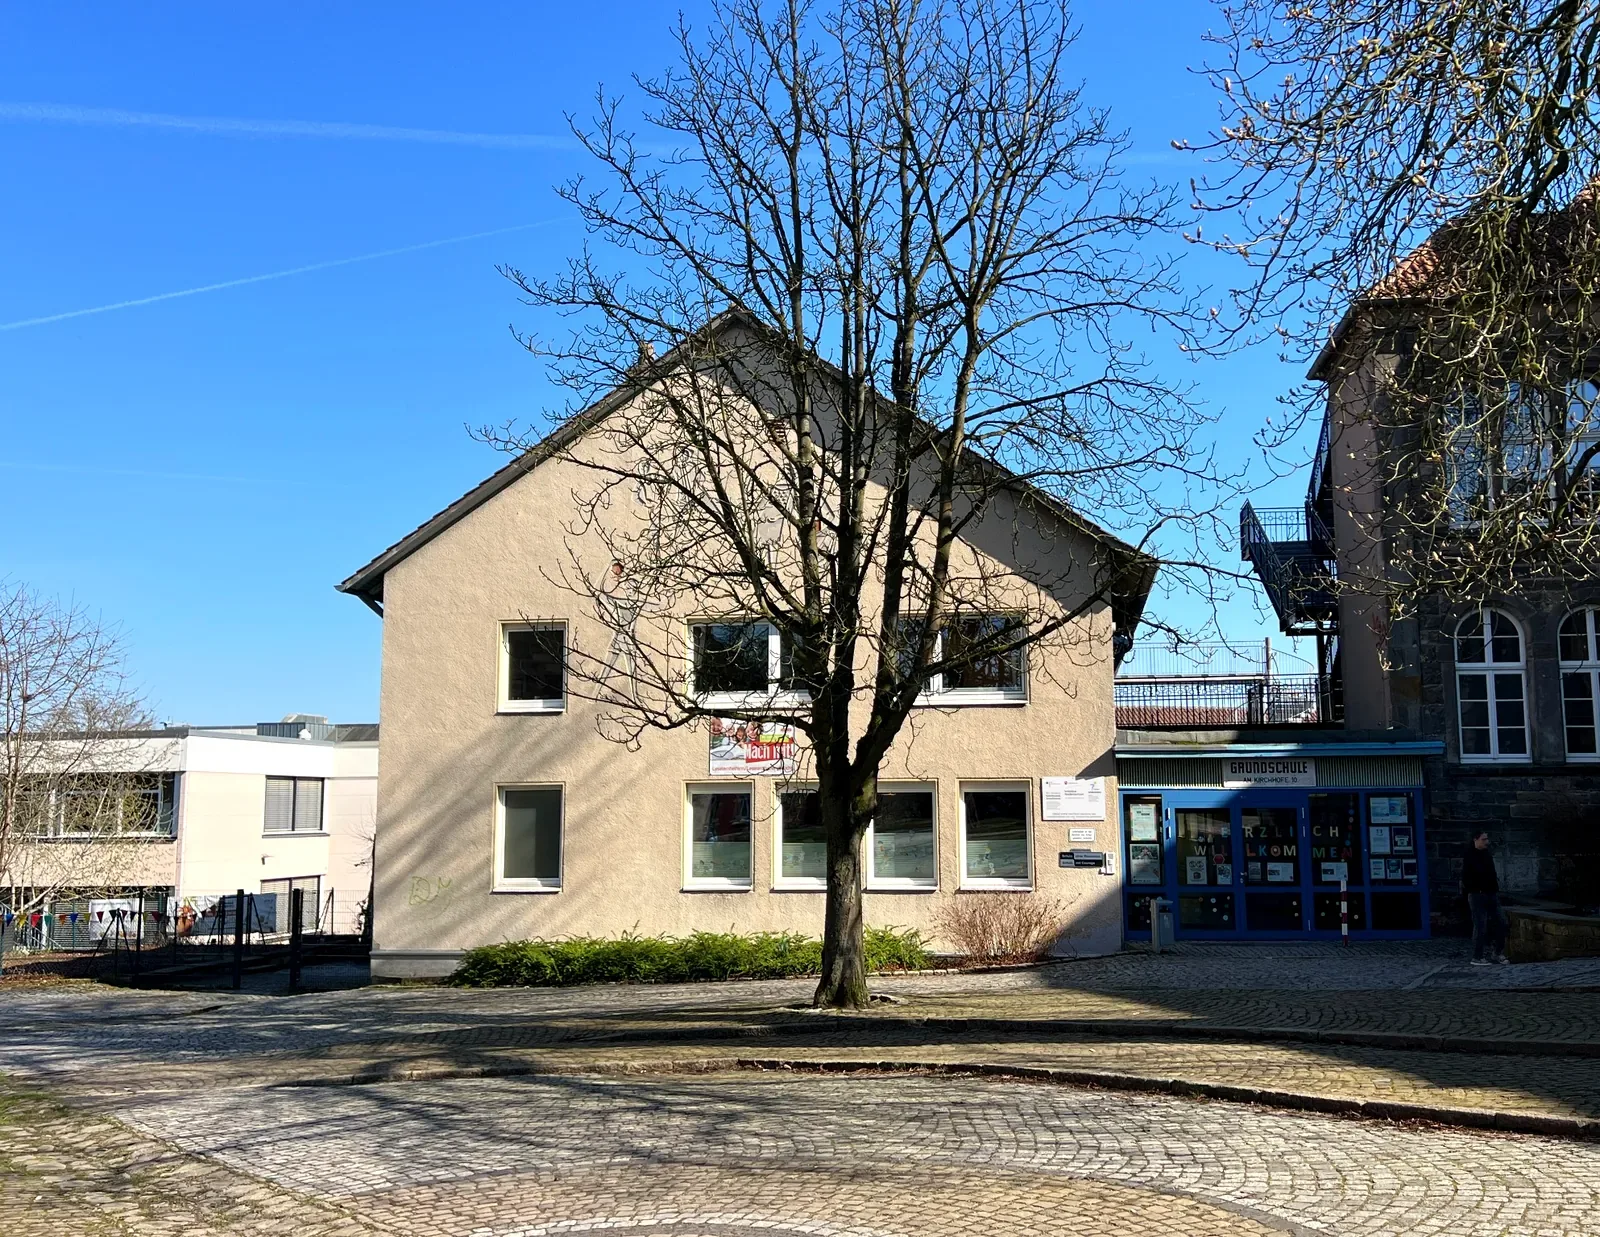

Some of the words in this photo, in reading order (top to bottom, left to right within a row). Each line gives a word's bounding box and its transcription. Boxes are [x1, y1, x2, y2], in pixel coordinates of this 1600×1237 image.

[744, 743, 770, 760] Mach
[1230, 761, 1308, 774] GRUNDSCHULE
[1254, 776, 1289, 784] KIRCHHOFE
[1194, 844, 1354, 860] WILLKOMMEN
